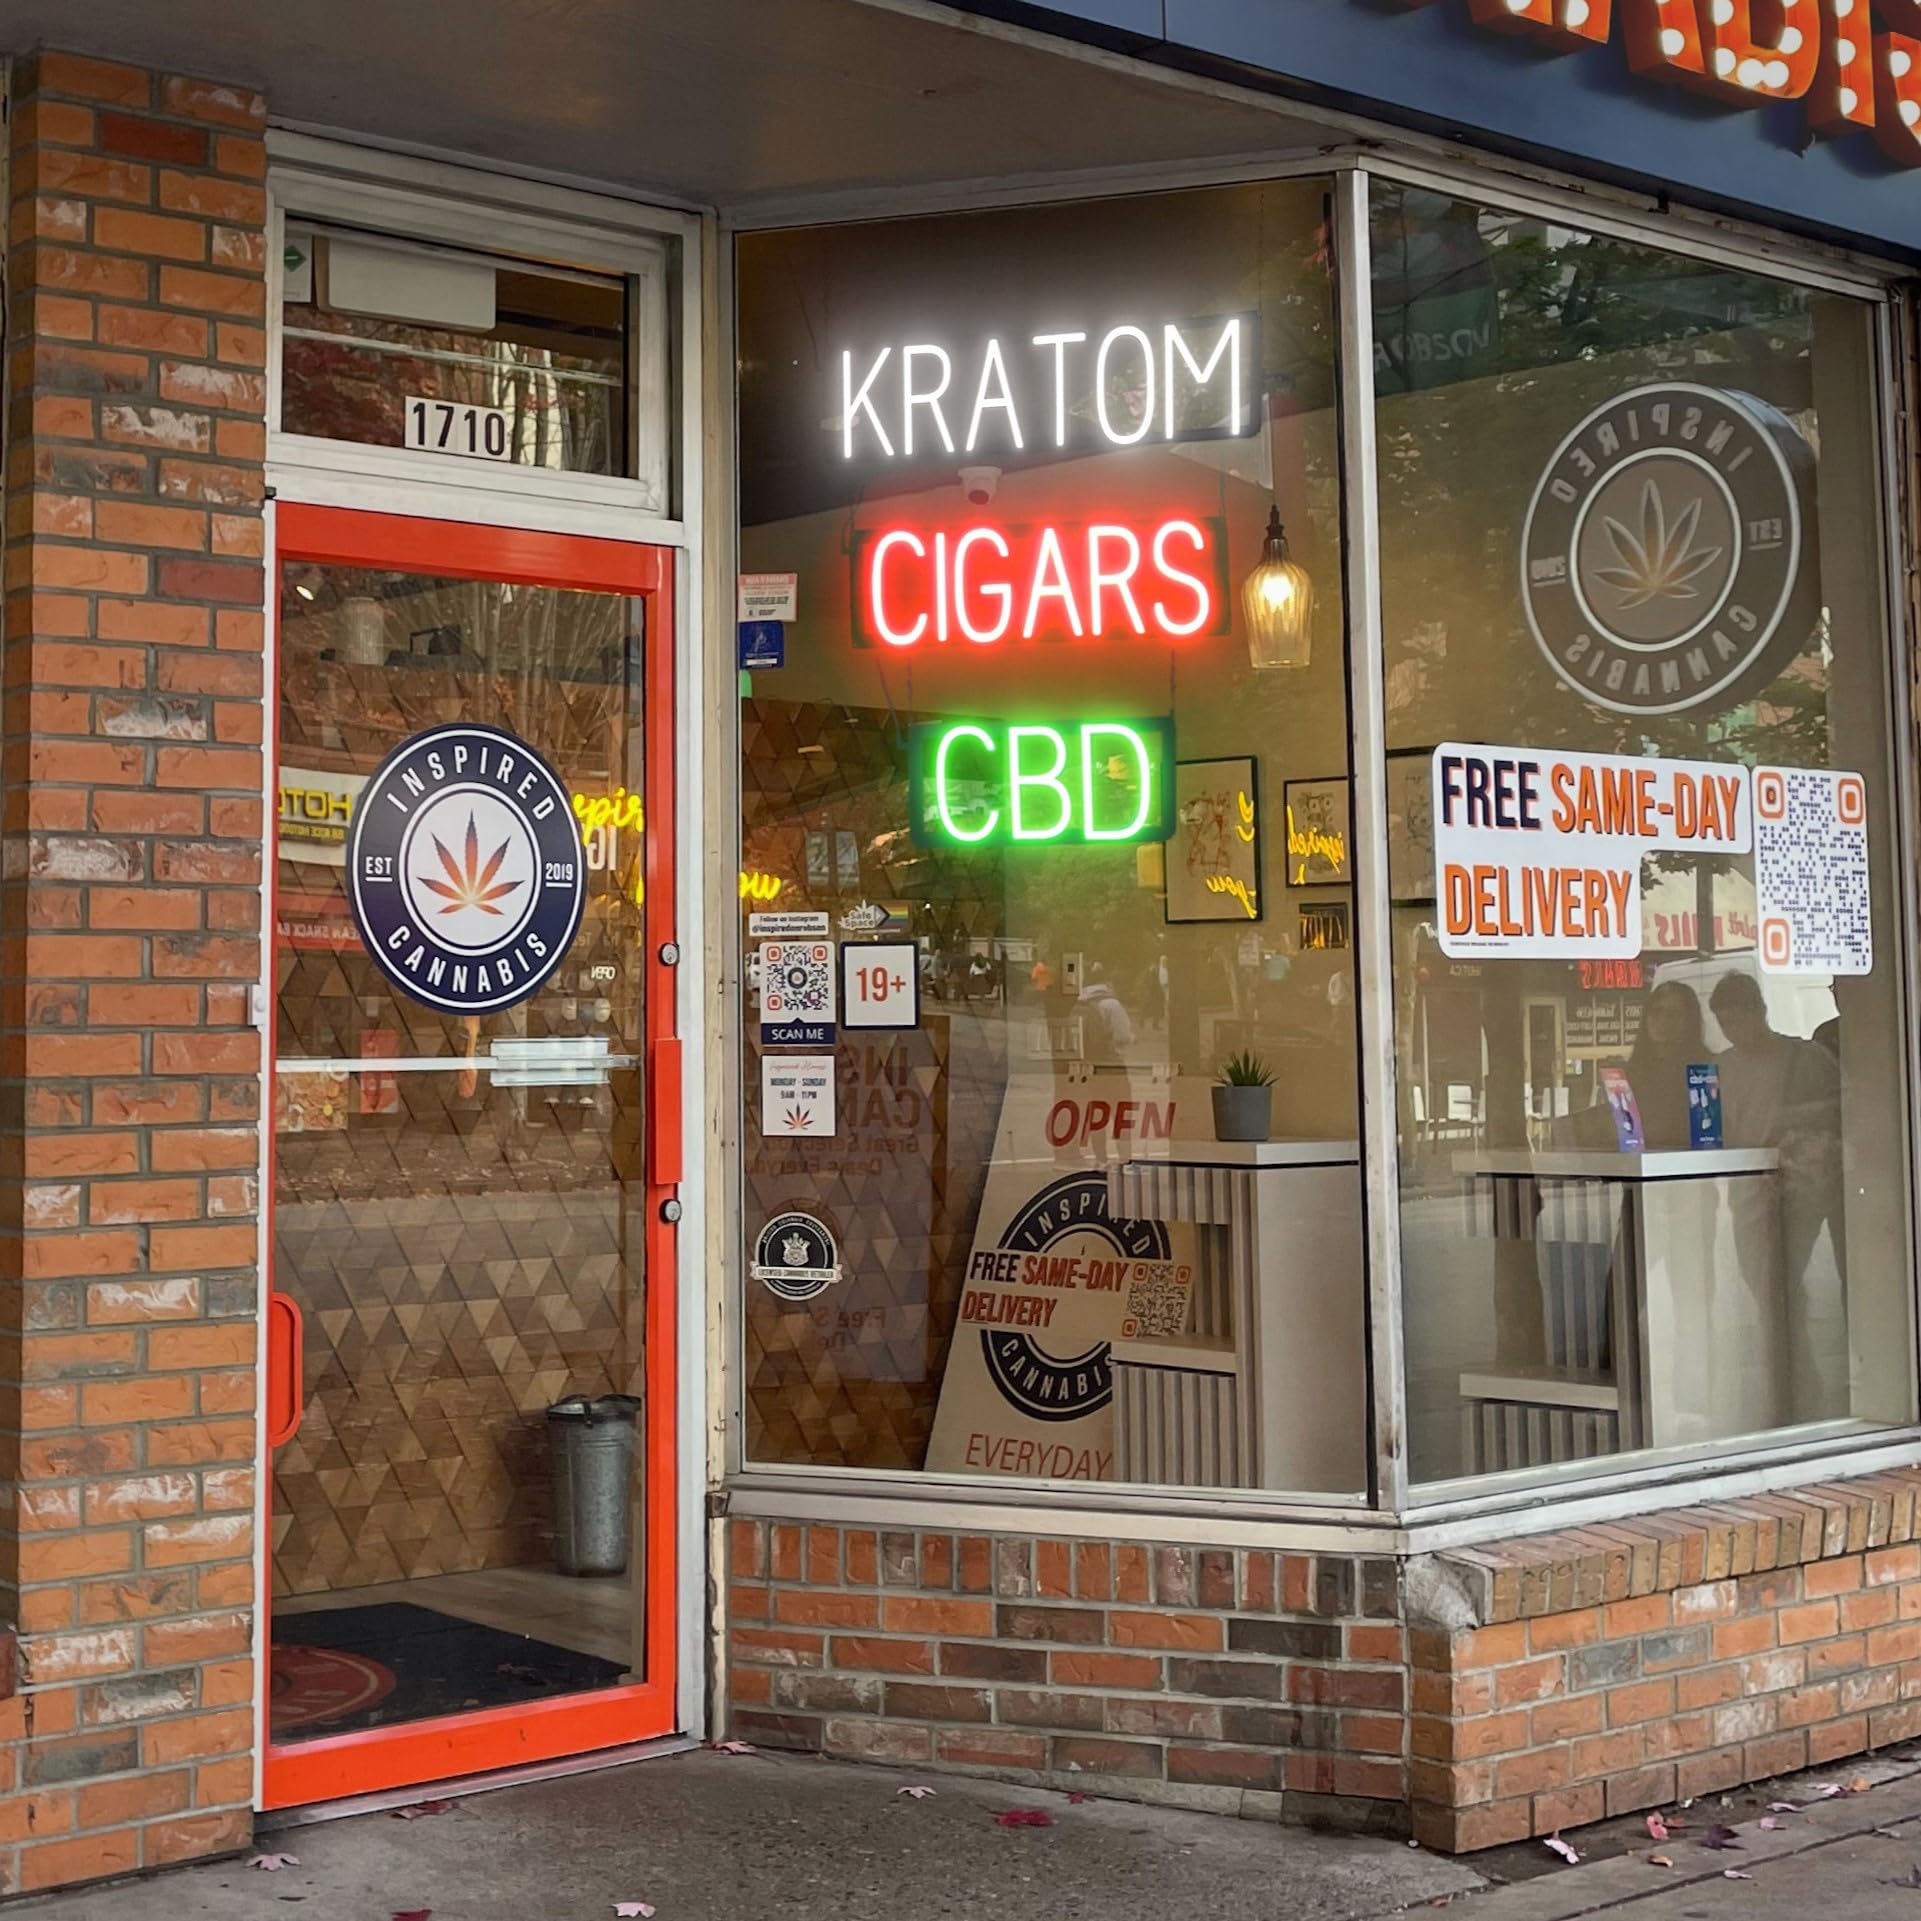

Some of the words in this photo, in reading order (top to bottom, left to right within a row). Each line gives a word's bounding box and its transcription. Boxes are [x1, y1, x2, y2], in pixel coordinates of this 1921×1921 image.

[841, 318, 1241, 459] KRATOM
[412, 402, 506, 456] 1710
[870, 520, 1211, 647] CIGARS
[387, 746, 556, 822] INSPIRED
[935, 723, 1154, 842] CBD
[1440, 755, 1542, 831] FREE
[1550, 762, 1741, 841] SAME-DAY
[365, 856, 393, 876] EST
[545, 862, 573, 881] 2019
[850, 911, 872, 920] Safe
[1444, 864, 1633, 938] DELIVERY
[387, 925, 548, 994] CANNABIS
[856, 966, 907, 1002] 19+
[771, 1029, 803, 1040] SCAN
[806, 1028, 825, 1040] ME
[1045, 1099, 1176, 1147] OPEN
[1024, 1192, 1150, 1255] INSPIED
[969, 1251, 1020, 1283] FREE
[1021, 1256, 1130, 1292] SAME-DAY
[961, 1291, 1058, 1328] DELIVERY
[964, 1434, 1114, 1481] EVERYDAY
